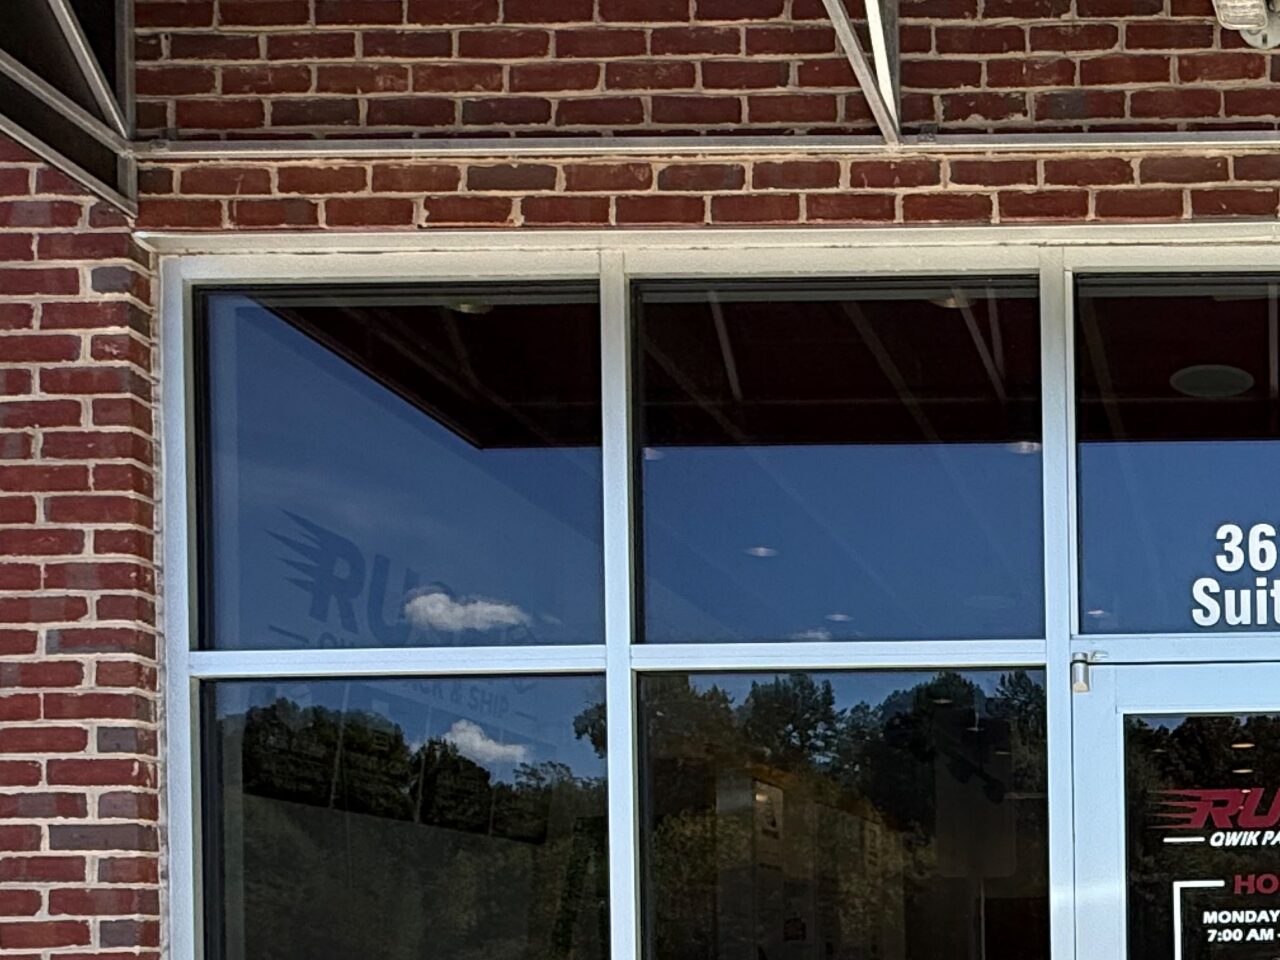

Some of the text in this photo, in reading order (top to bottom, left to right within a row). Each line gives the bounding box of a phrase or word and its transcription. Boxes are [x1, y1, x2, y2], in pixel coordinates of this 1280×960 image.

[1210, 831, 1259, 846] QWIK
[1203, 909, 1280, 924] MONDAY
[1207, 928, 1243, 942] 7:00
[1246, 928, 1274, 941] AM
